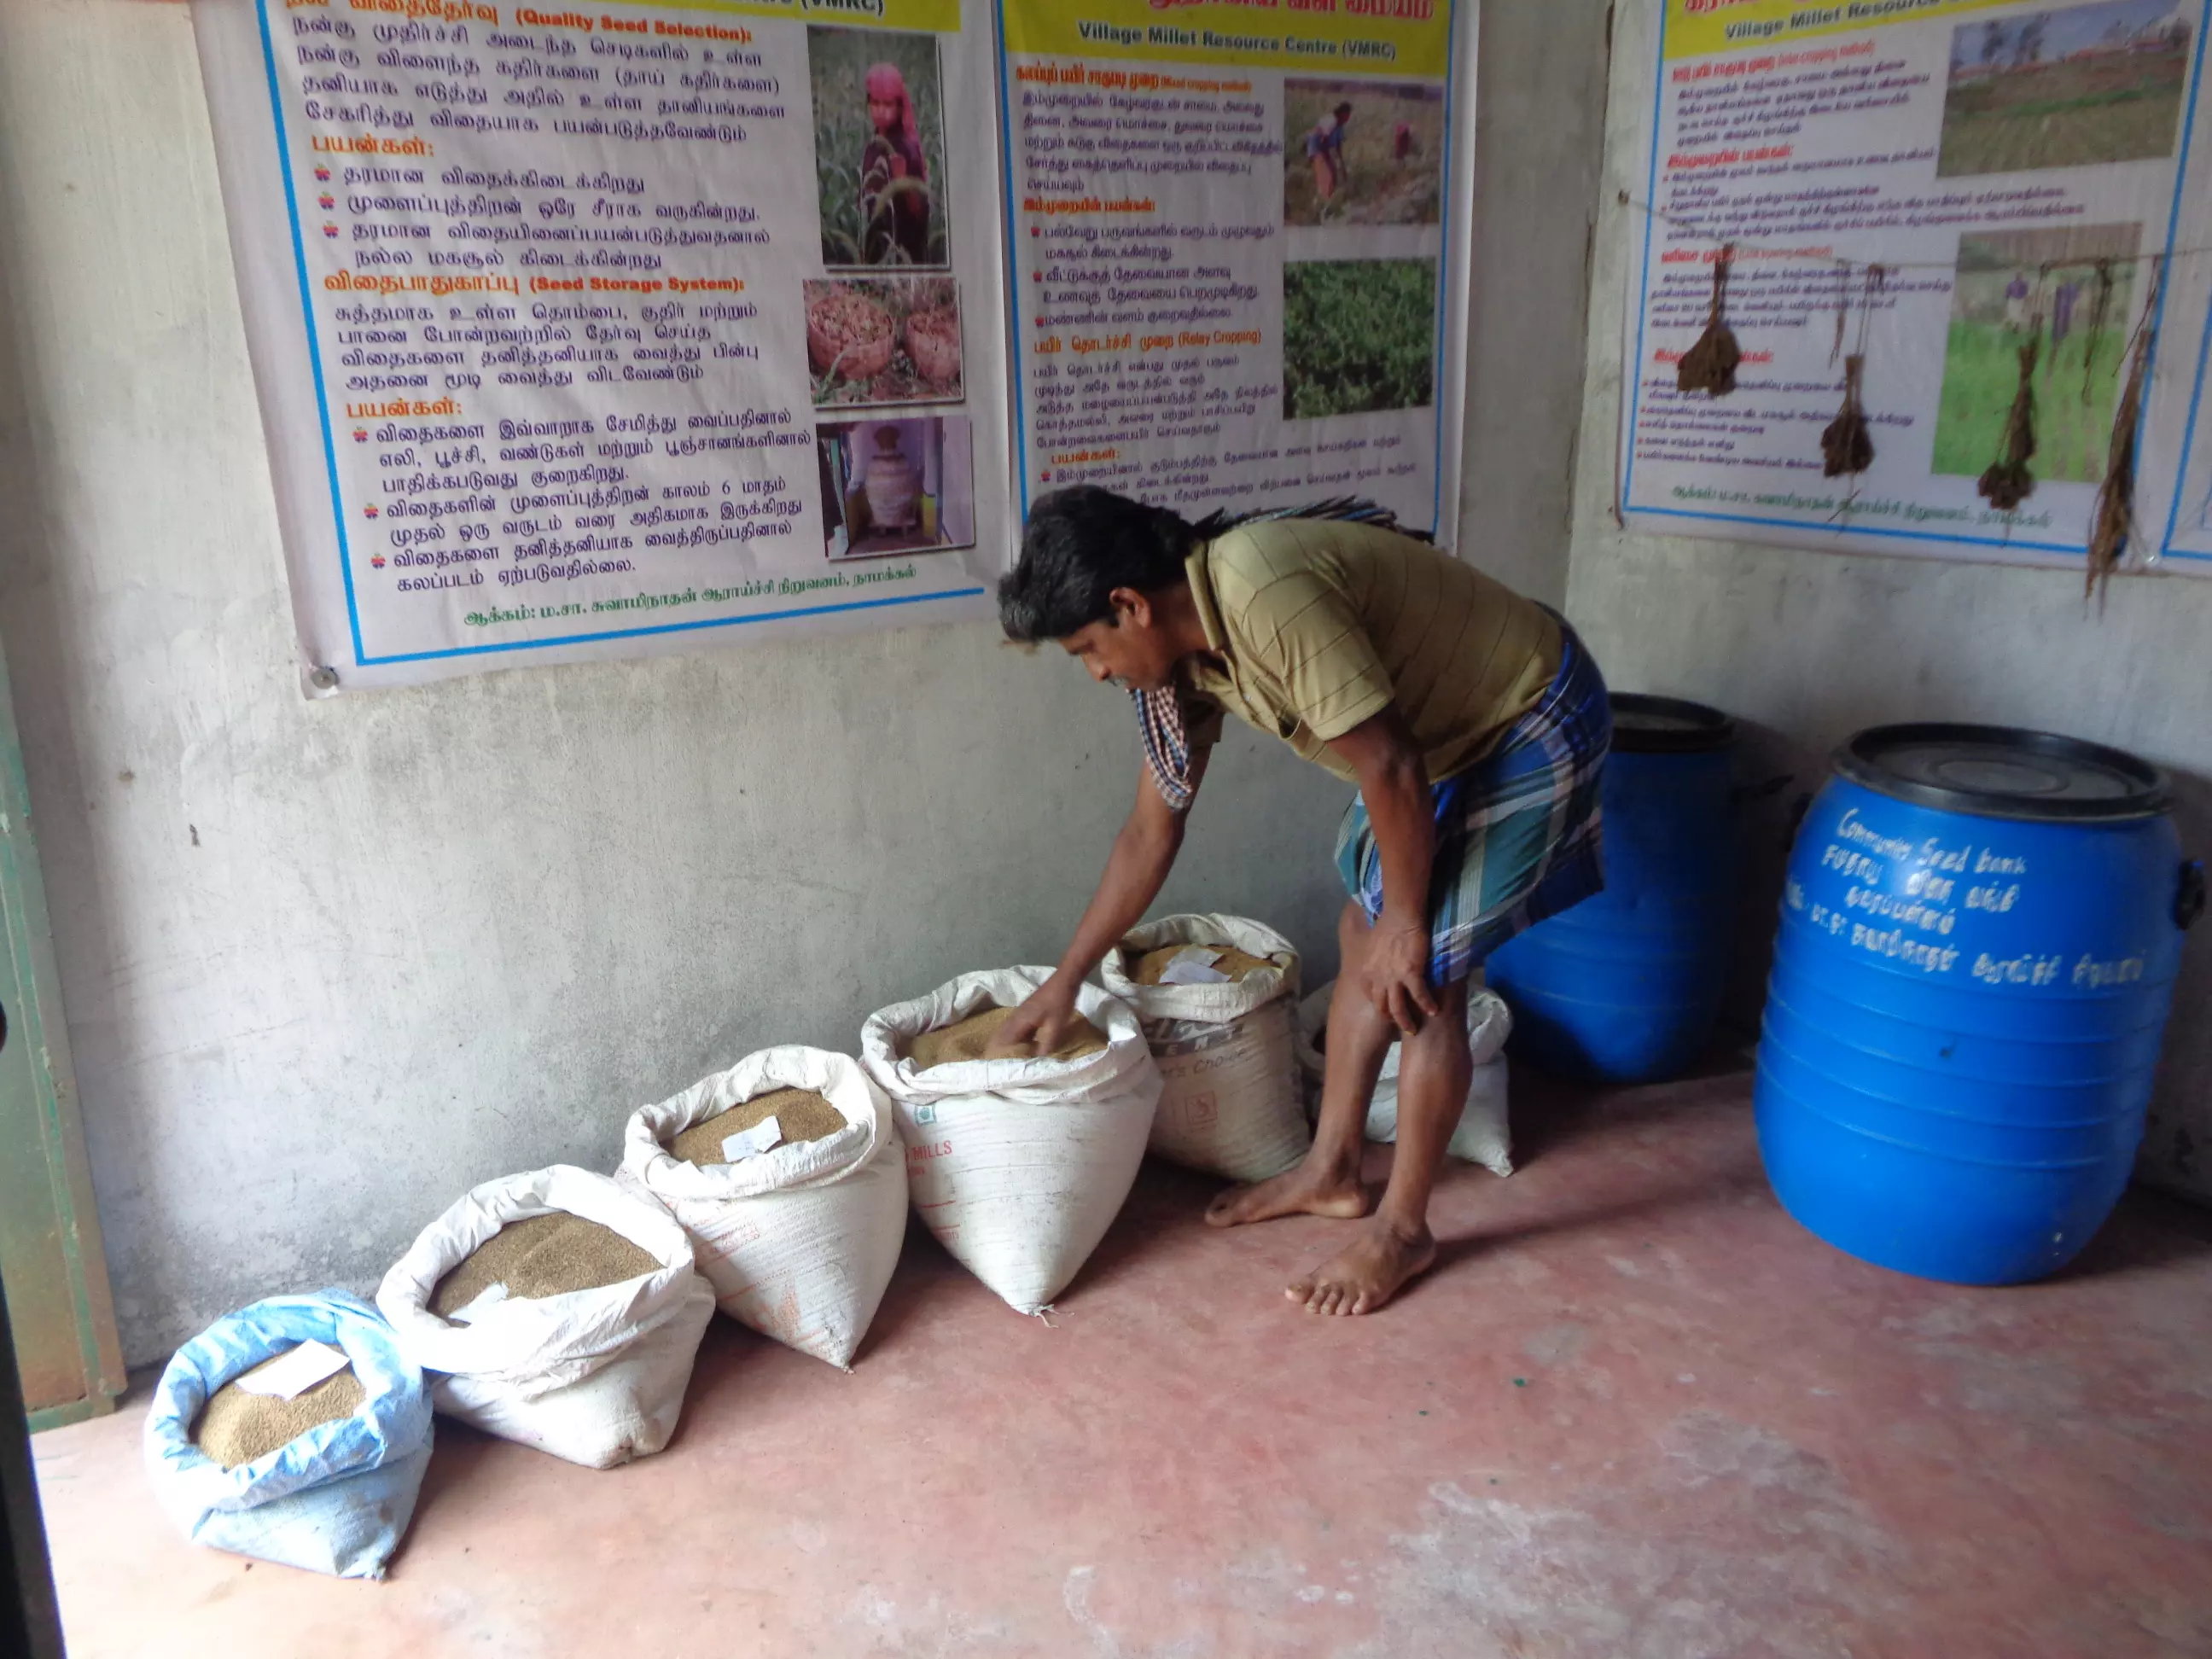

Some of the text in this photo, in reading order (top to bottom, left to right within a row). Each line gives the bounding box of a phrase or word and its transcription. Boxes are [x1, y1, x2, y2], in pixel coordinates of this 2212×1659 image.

[515, 9, 754, 44] (Quality Seed Selection):
[1726, 20, 1784, 39] Village
[1790, 9, 1840, 29] Millet
[292, 16, 761, 67] நன்கு முதிர்ச்சி அடைந்த செடிகளில் உள்ள
[1079, 20, 1397, 61] Village Millet Resource Centre (VMRC)
[297, 45, 779, 94] நன்கு விளைந்த கதிர்களை (தாய் கதிர்களை)
[302, 75, 784, 118] தனியாக எடுத்து அதில் உள்ள தானியங்களை
[305, 102, 747, 143] சேகரித்து விதையாக பயன்படுத்தவேண்டும்
[311, 135, 434, 157] பயன்கள்:
[1025, 134, 1064, 154] மற்றும்
[343, 166, 644, 195] தரமான விதைக்கிடைக்கிறது
[346, 195, 521, 217] முளைப்புத்திறன்
[538, 199, 575, 220] ஒரே
[592, 200, 642, 219] சீராக
[352, 223, 770, 246] தரமான விதையினைப்பயன்படுத்துவதனால்
[355, 247, 661, 271] நல்ல மகசூல் கிடைக்கின்றது
[1045, 245, 1088, 262] மகசூல்
[323, 272, 745, 296] விதைபாதுகாப்பு (Seed Storage System):
[1194, 265, 1231, 280] அளவு
[335, 304, 434, 324] சுத்தமாக
[449, 304, 515, 321] உள்ள
[641, 301, 684, 324] குதிர்
[699, 302, 758, 321] மற்றும்
[1113, 308, 1144, 324] வளம்
[338, 323, 711, 346] பானை போன்றவற்றில் தேர்வு செய்த
[1033, 335, 1062, 357] பயிர்
[1138, 335, 1174, 352] முறை
[1178, 331, 1211, 347] (Relay
[1213, 329, 1261, 346] Cropping)
[341, 341, 759, 368] விதைகளை தனித்தனியாக வைத்து பின்பு
[1171, 357, 1201, 372] முதல்
[346, 364, 703, 392] அதனை மூடி வைத்து விடவேண்டும்
[1081, 379, 1109, 394] அதே
[346, 397, 462, 419] பயன்கள்:
[375, 408, 791, 444] விதைகளை இவ்வாறாக சேமித்து வைப்பதினால்
[499, 442, 585, 462] வண்டுகள்
[597, 438, 654, 459] மற்றும்
[665, 430, 811, 457] பூஞ்சானங்களினால்
[1050, 447, 1121, 466] பயன்கள்:
[382, 471, 518, 494] பாதிக்கபடுவது
[387, 476, 786, 518] விதைகளின் முளைப்புத்திறன் காலம் 6 மாதம்
[390, 499, 802, 547] முதல் ஒரு வருடம் வரை அதிகமாக இருக்கிறது
[393, 521, 792, 568] விதைகளை தனித்தனியாக வைத்திருப்பதினால்
[397, 569, 484, 591] கலப்படம்
[1915, 836, 1972, 873] Seed
[911, 1139, 953, 1161] MILLS
